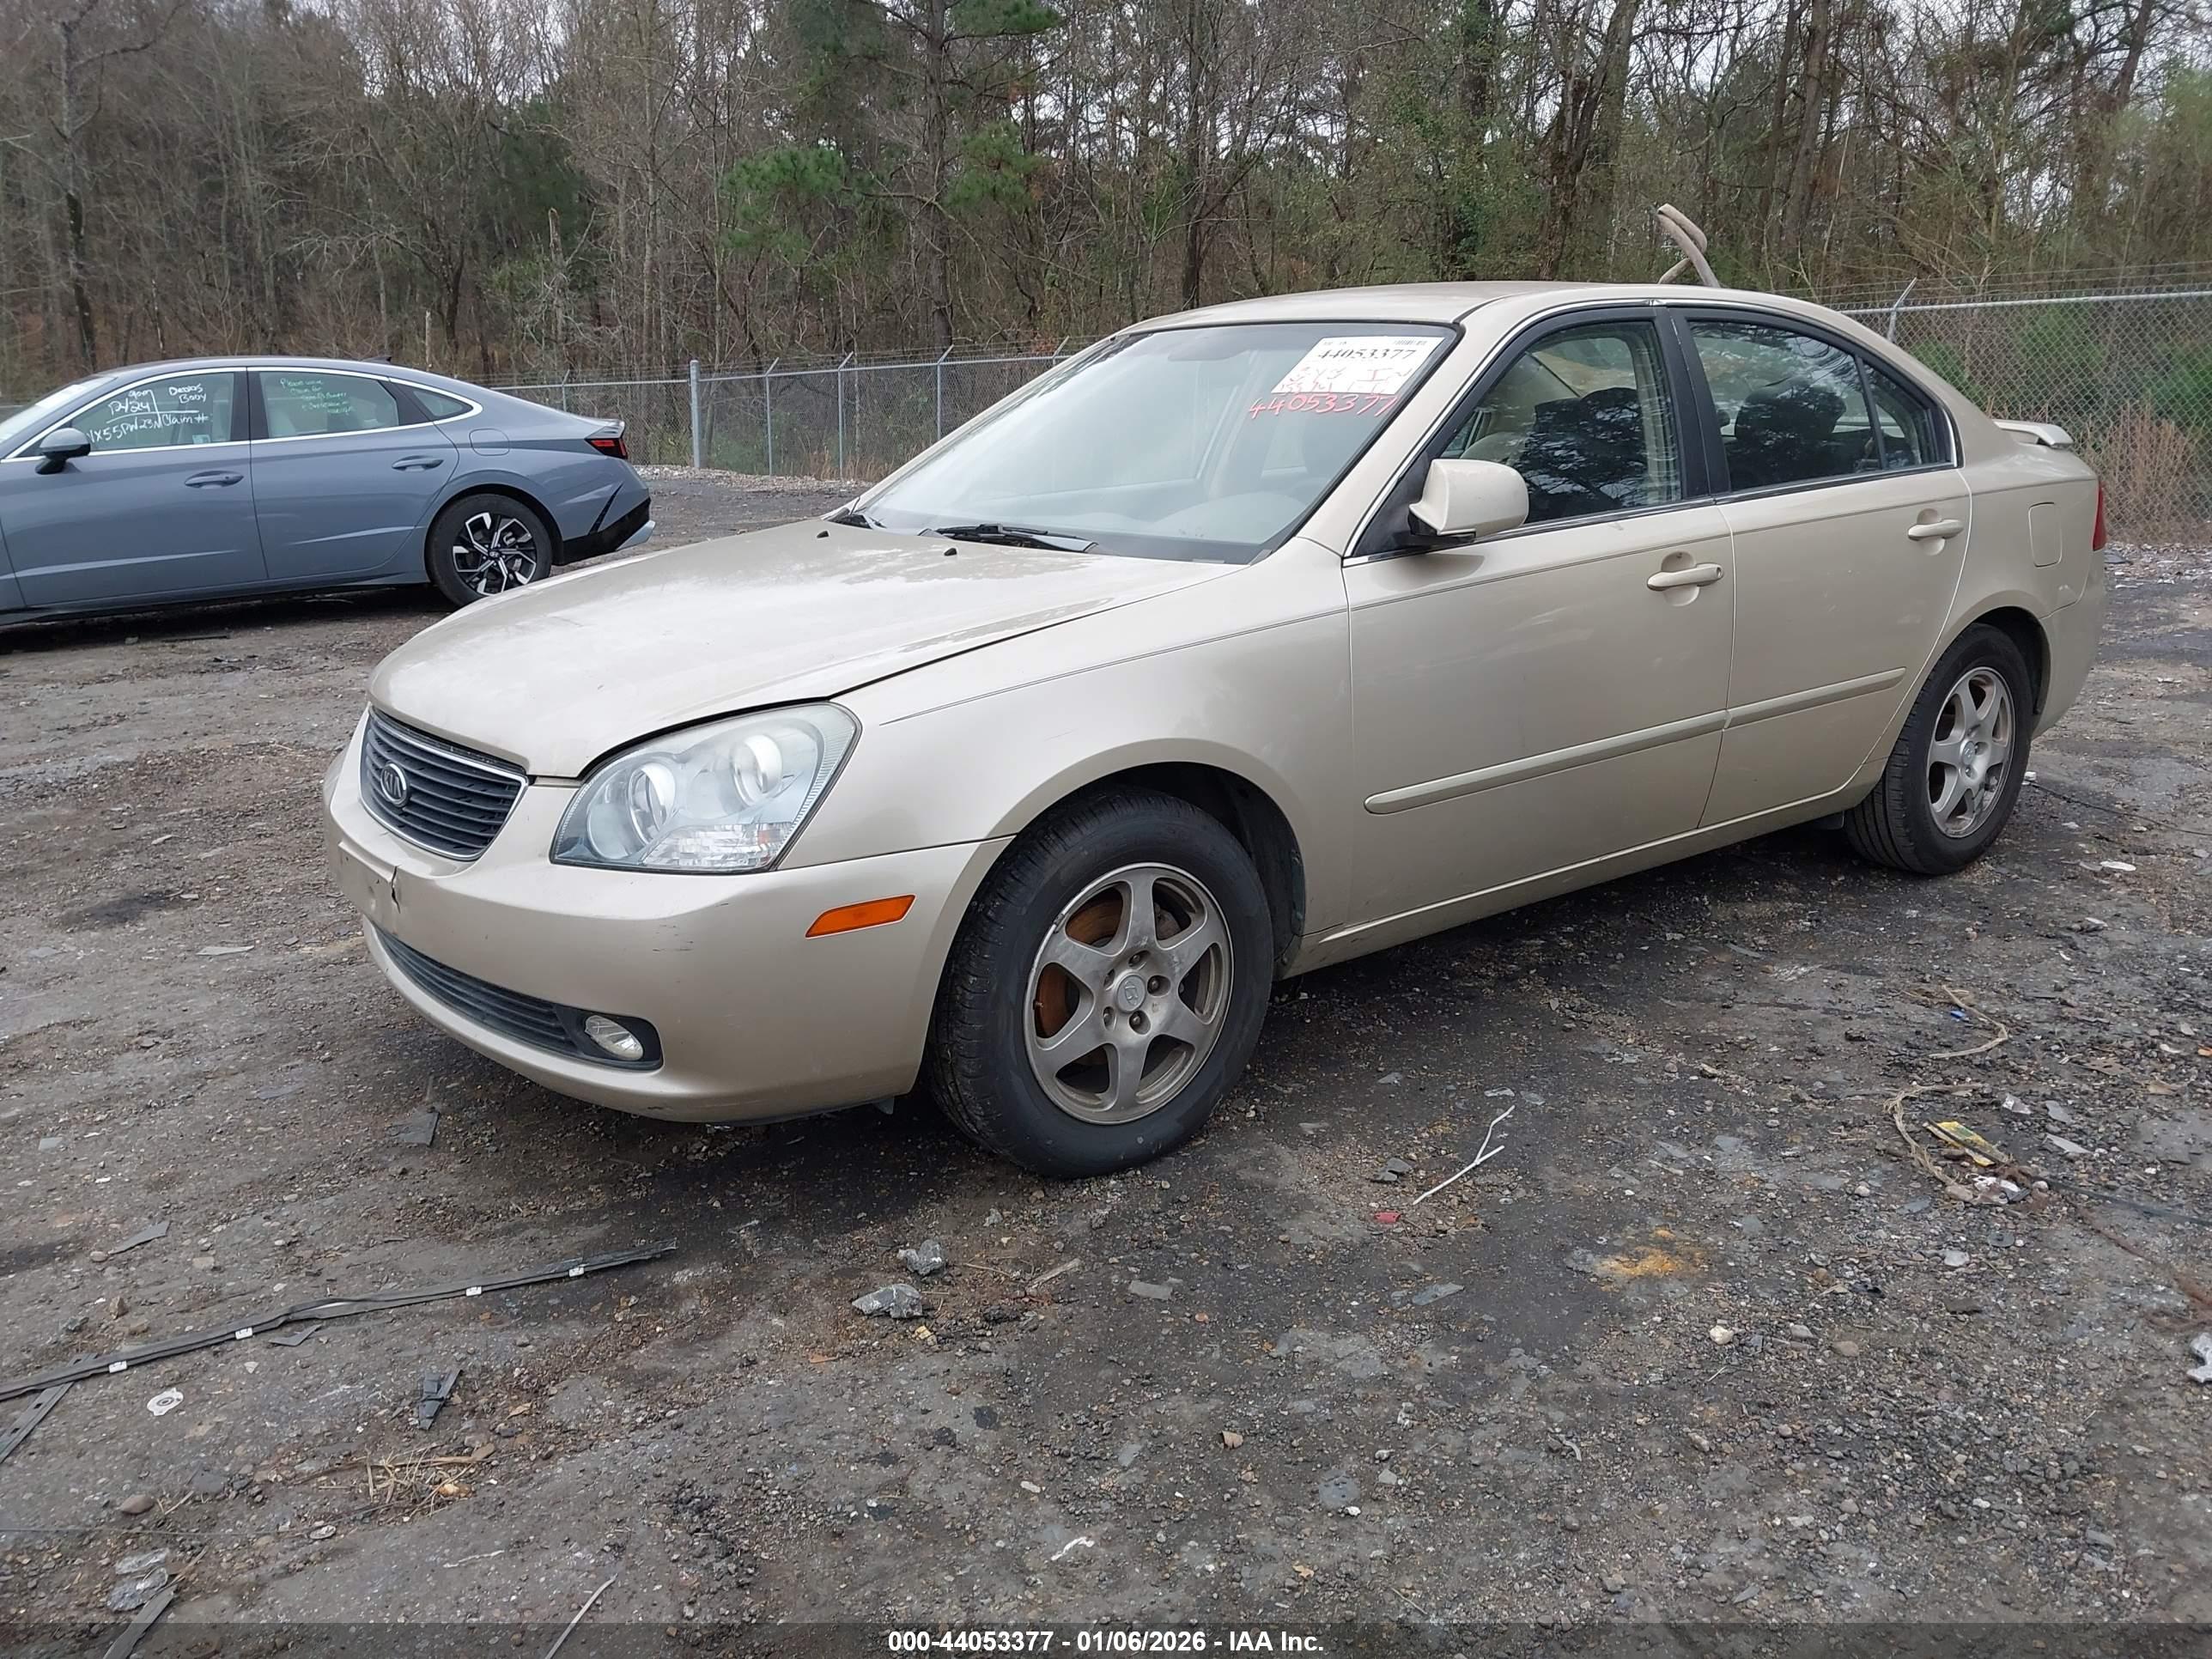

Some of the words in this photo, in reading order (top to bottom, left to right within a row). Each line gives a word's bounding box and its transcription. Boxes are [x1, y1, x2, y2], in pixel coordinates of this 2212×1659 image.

[1317, 348, 1417, 359] 44053377
[1249, 393, 1399, 419] 44053377
[384, 769, 402, 798] KIA
